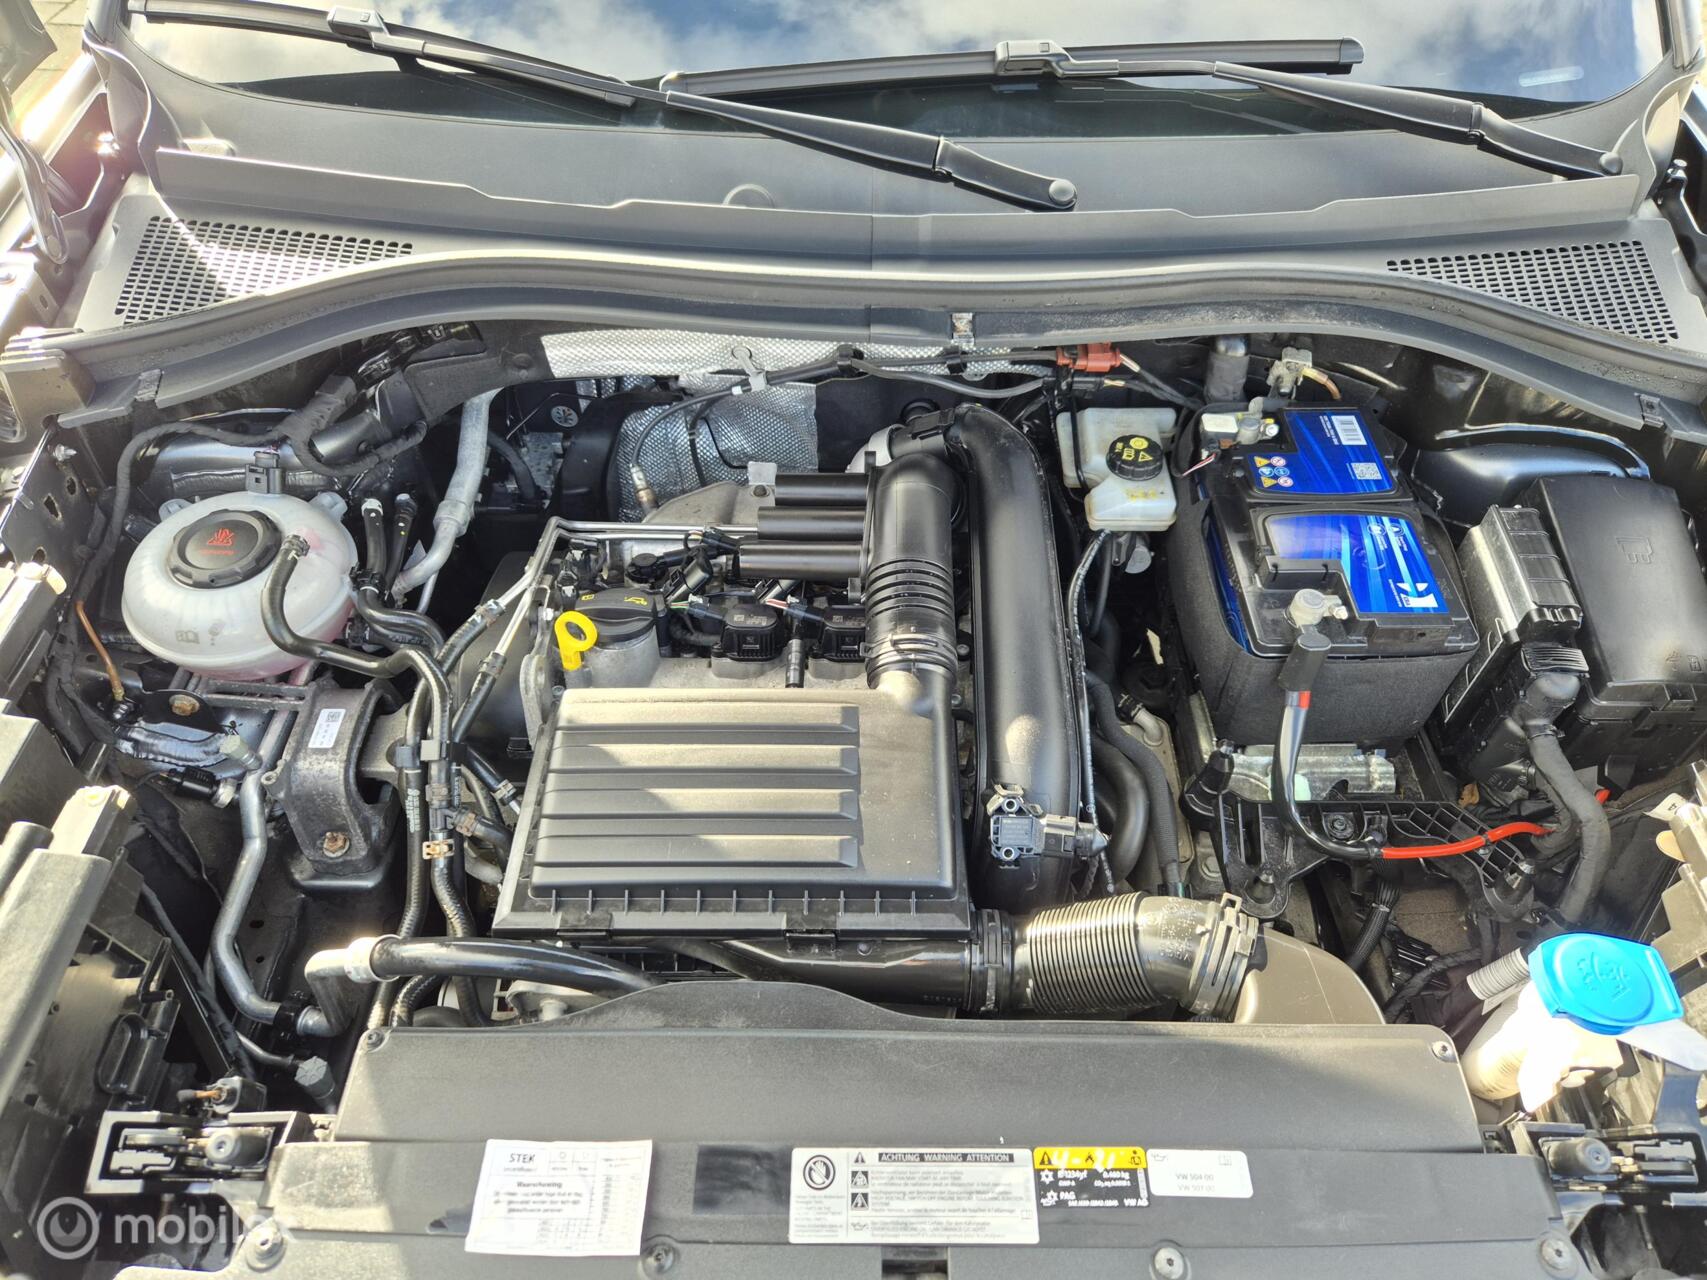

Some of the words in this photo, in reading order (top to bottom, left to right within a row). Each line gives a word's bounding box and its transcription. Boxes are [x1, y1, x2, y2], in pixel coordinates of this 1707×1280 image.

[881, 1152, 920, 1162] ACHTUNG
[923, 1152, 963, 1162] WARNING
[966, 1152, 1010, 1162] ATTENTION
[1175, 1172, 1189, 1181] VW
[1123, 1198, 1137, 1207] VW
